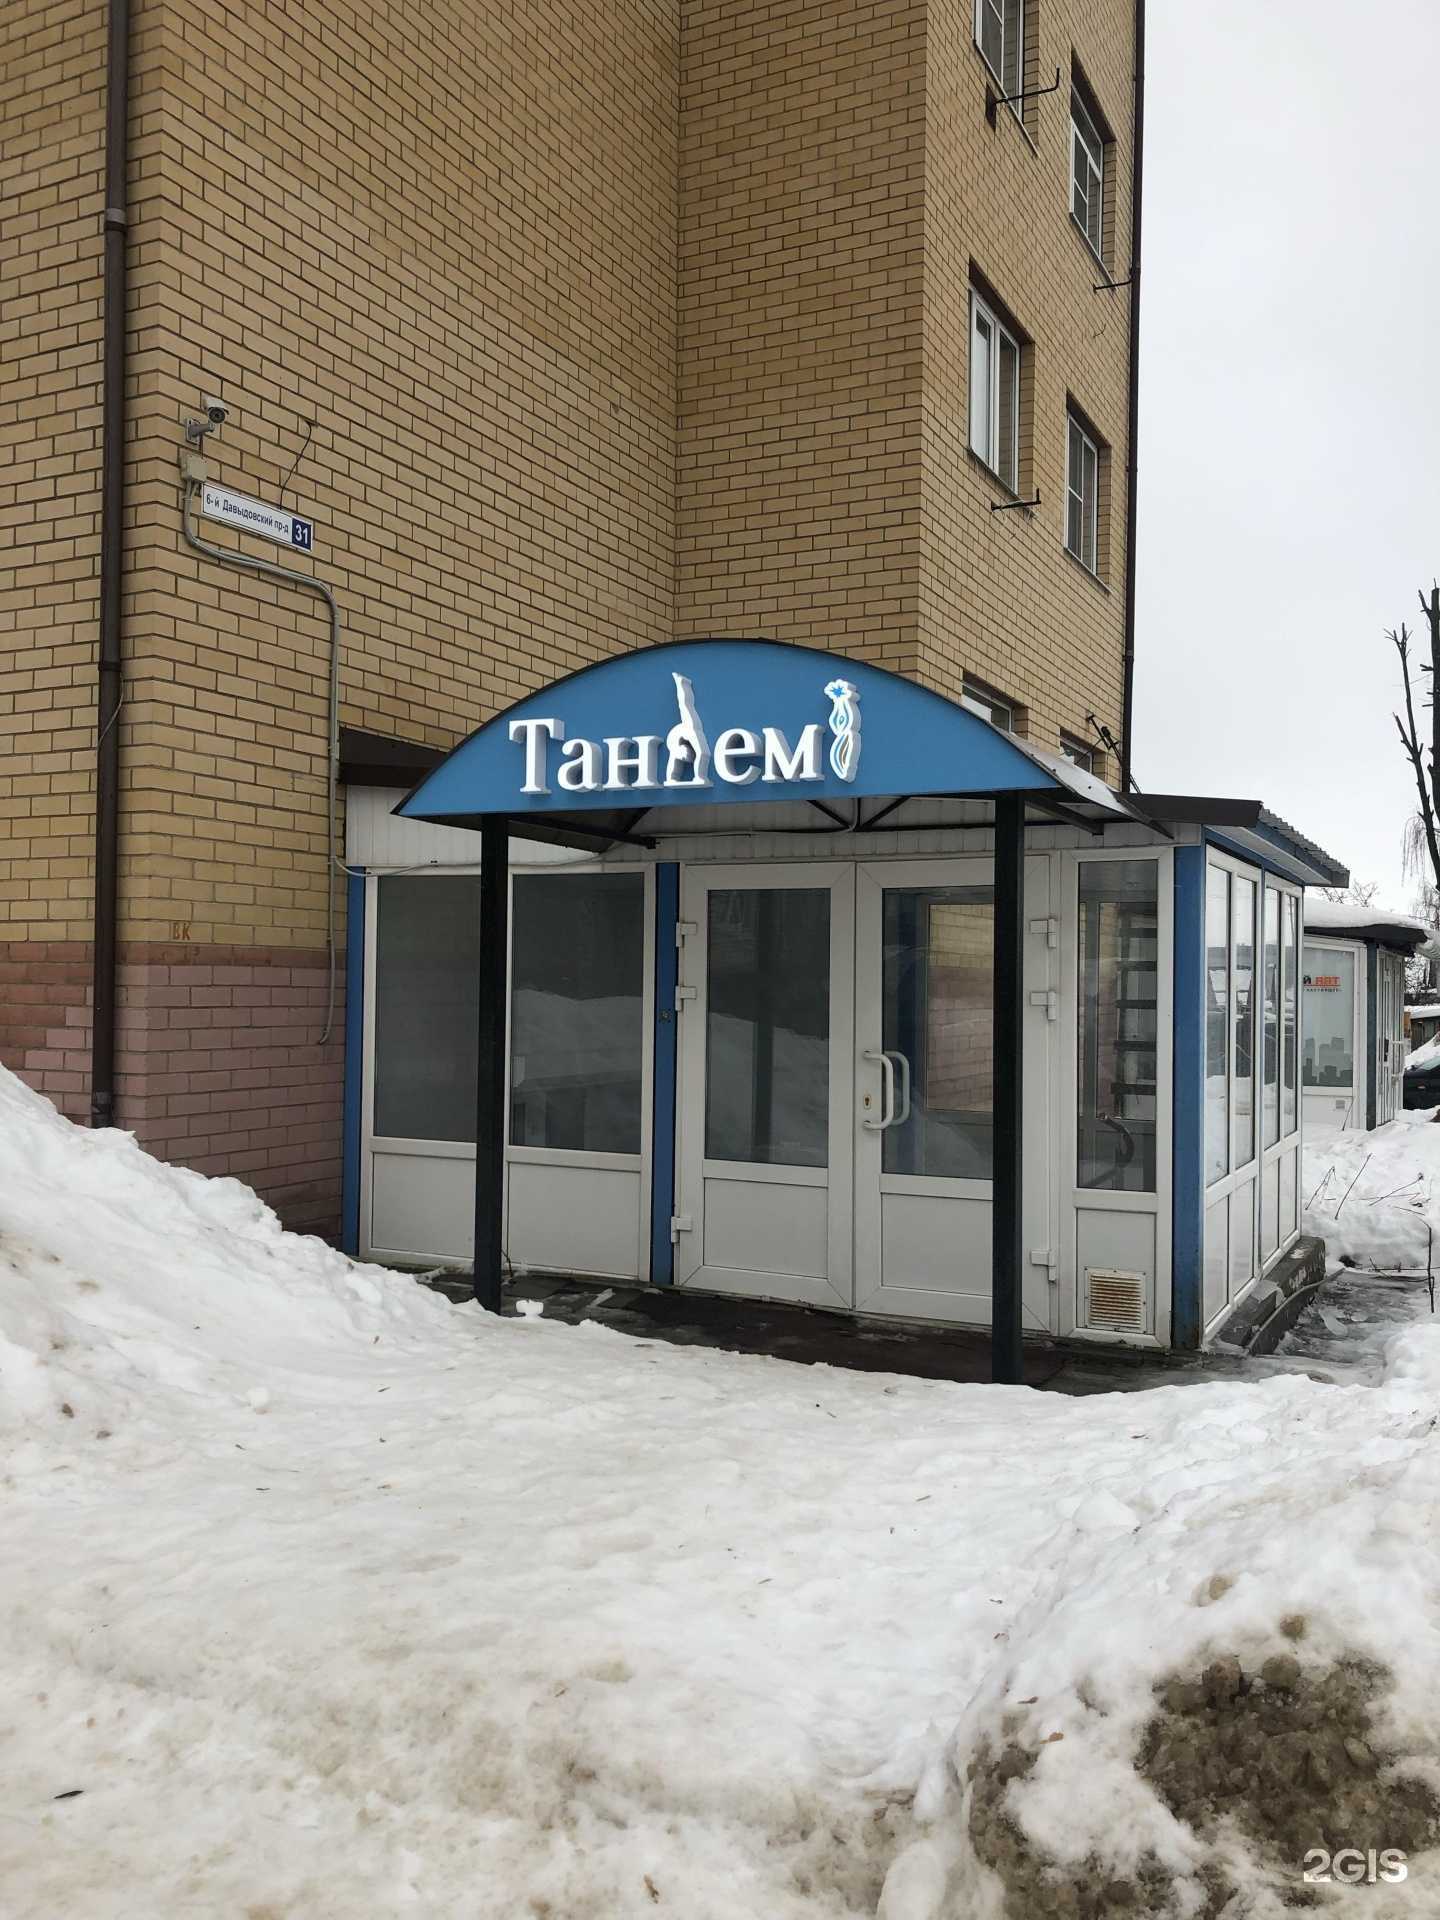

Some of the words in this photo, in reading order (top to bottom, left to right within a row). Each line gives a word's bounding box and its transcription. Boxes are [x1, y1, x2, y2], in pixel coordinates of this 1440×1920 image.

[222, 500, 273, 527] Давыдовский
[274, 519, 289, 534] пр-д
[295, 524, 309, 545] 31
